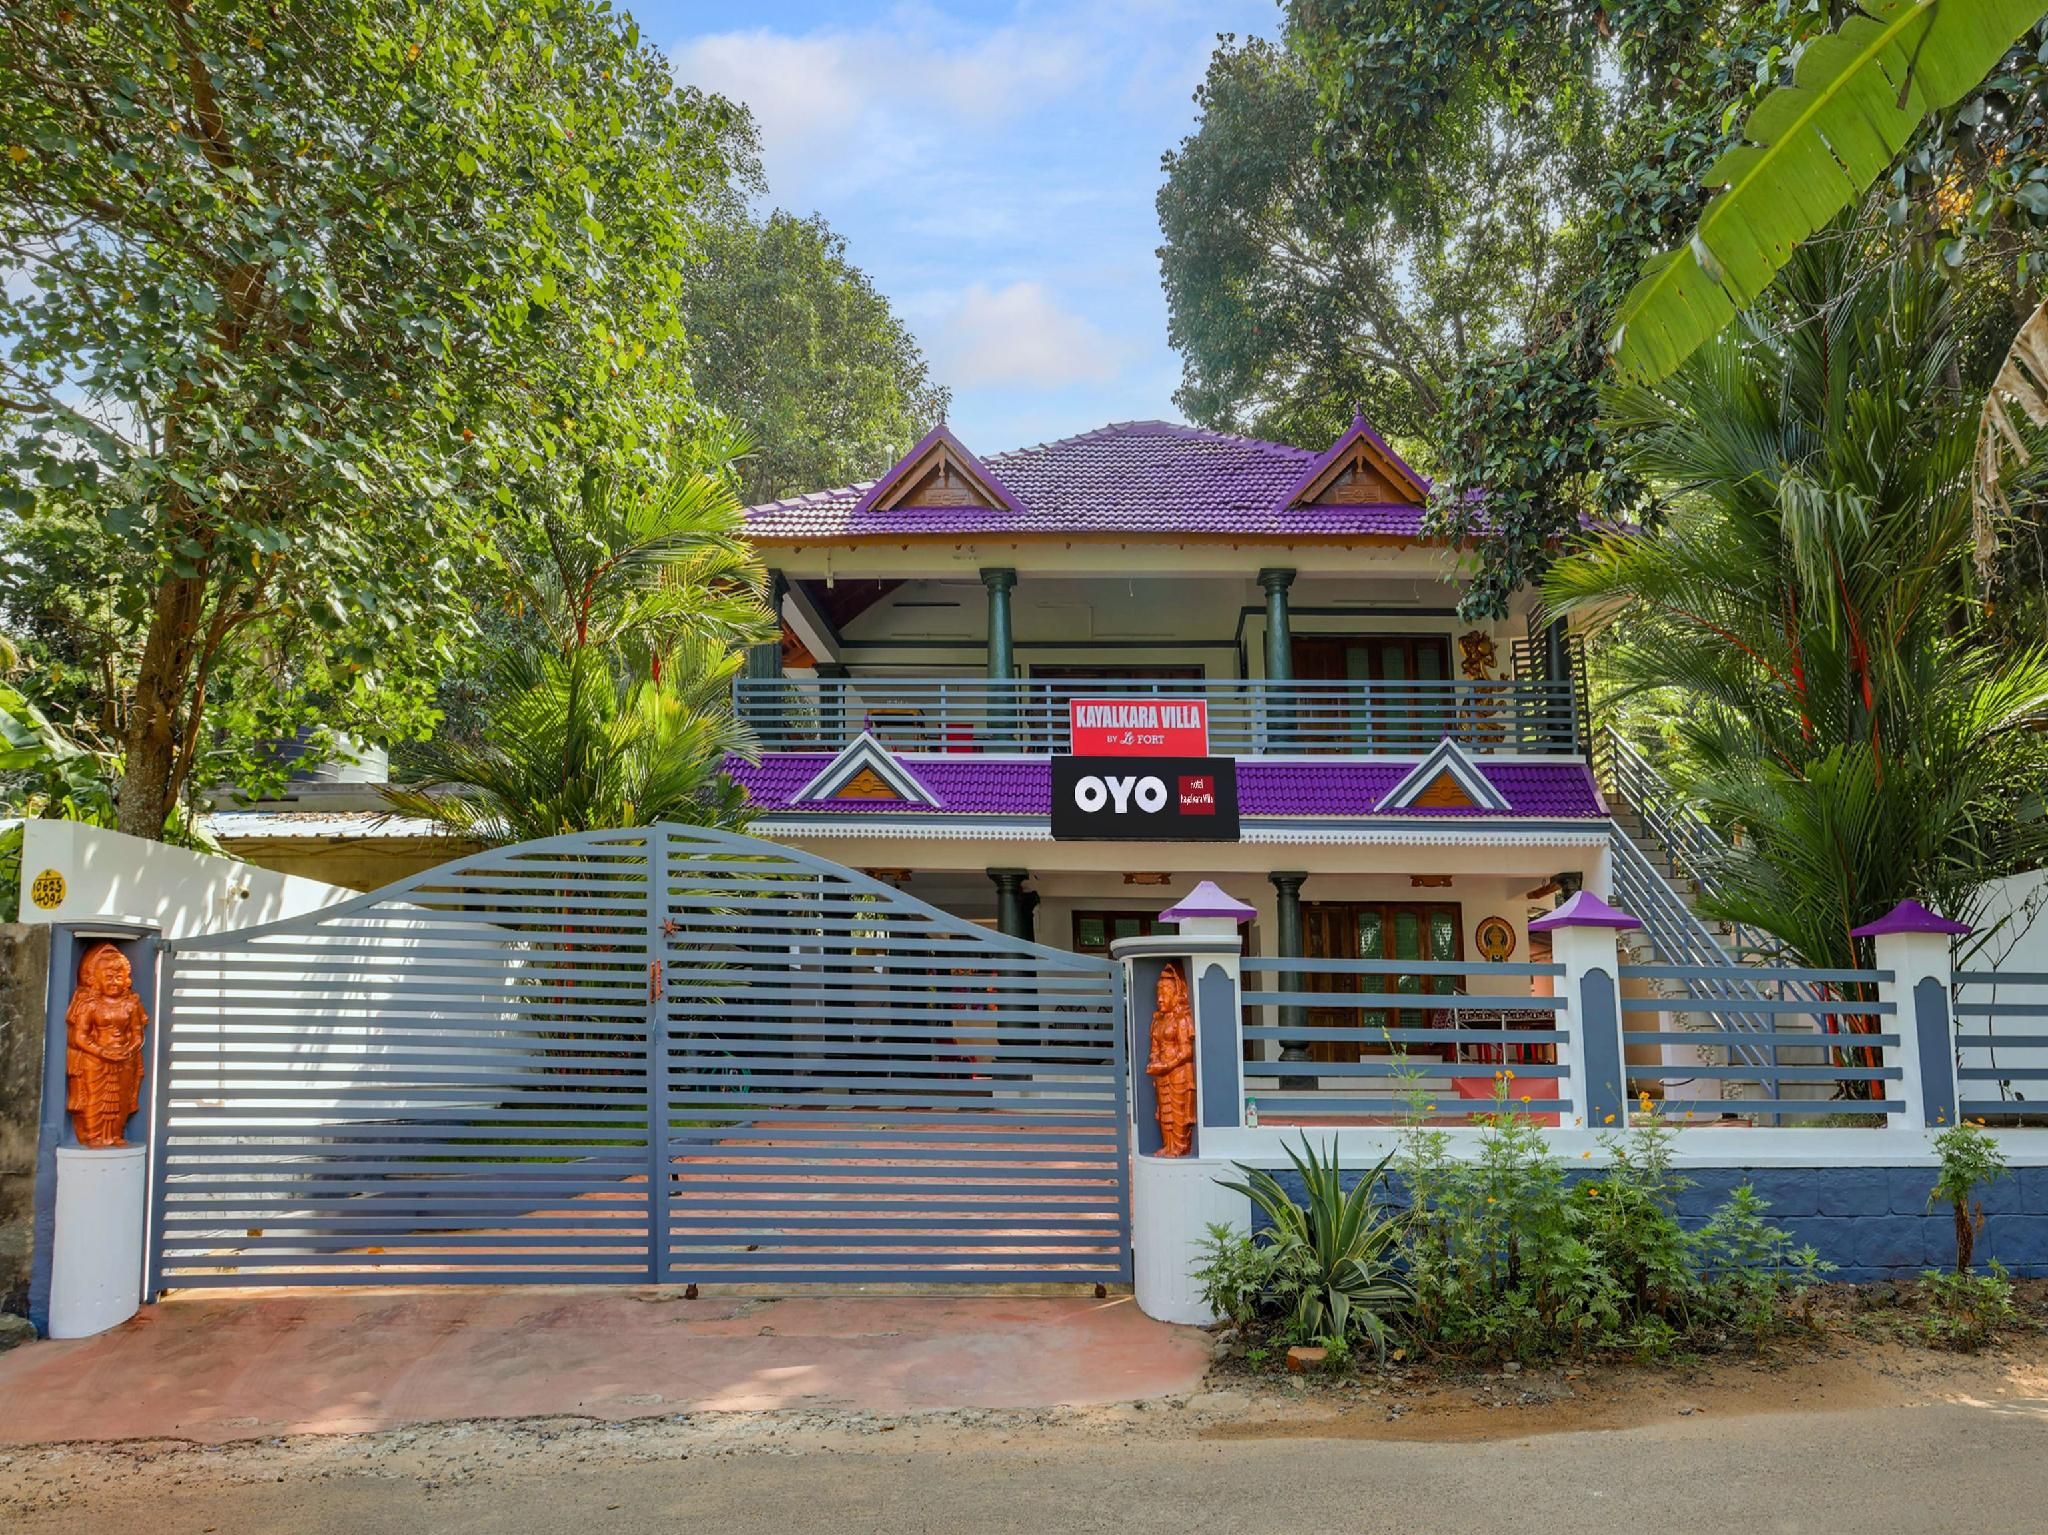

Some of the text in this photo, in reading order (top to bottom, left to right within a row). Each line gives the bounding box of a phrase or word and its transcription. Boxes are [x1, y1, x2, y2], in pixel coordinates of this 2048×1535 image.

[1076, 705, 1201, 729] KAYALKARA VILLA
[1107, 735, 1117, 743] BY
[1137, 735, 1165, 744] FORT
[1074, 776, 1168, 814] OYO
